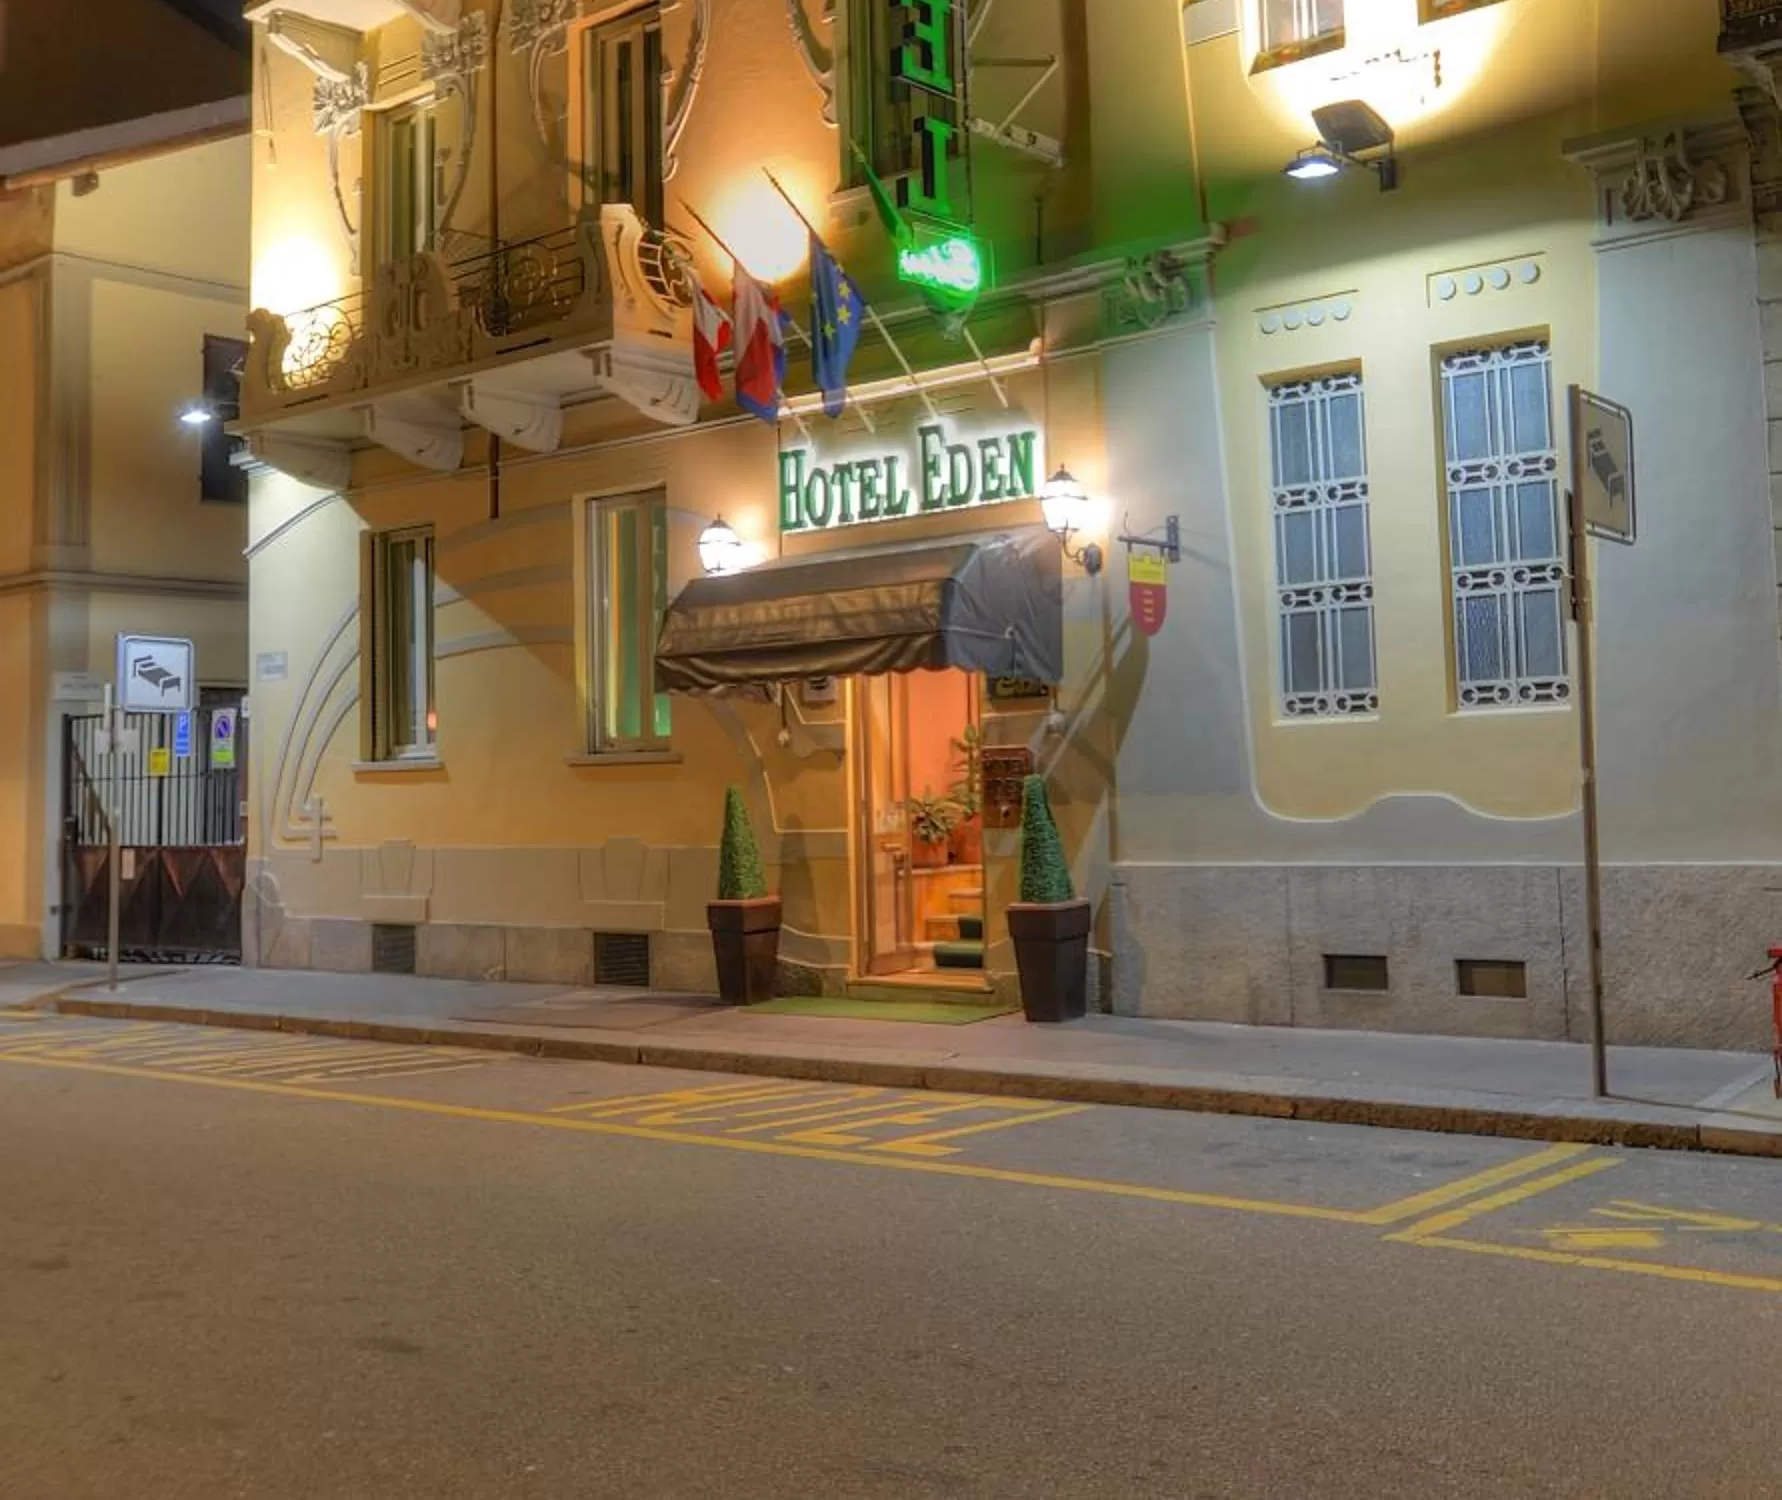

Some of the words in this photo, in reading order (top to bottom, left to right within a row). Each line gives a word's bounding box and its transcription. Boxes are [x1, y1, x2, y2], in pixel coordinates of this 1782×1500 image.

[779, 449, 910, 531] HOTEL
[917, 424, 1036, 511] EDEN
[543, 1078, 1097, 1156] HOTEL
